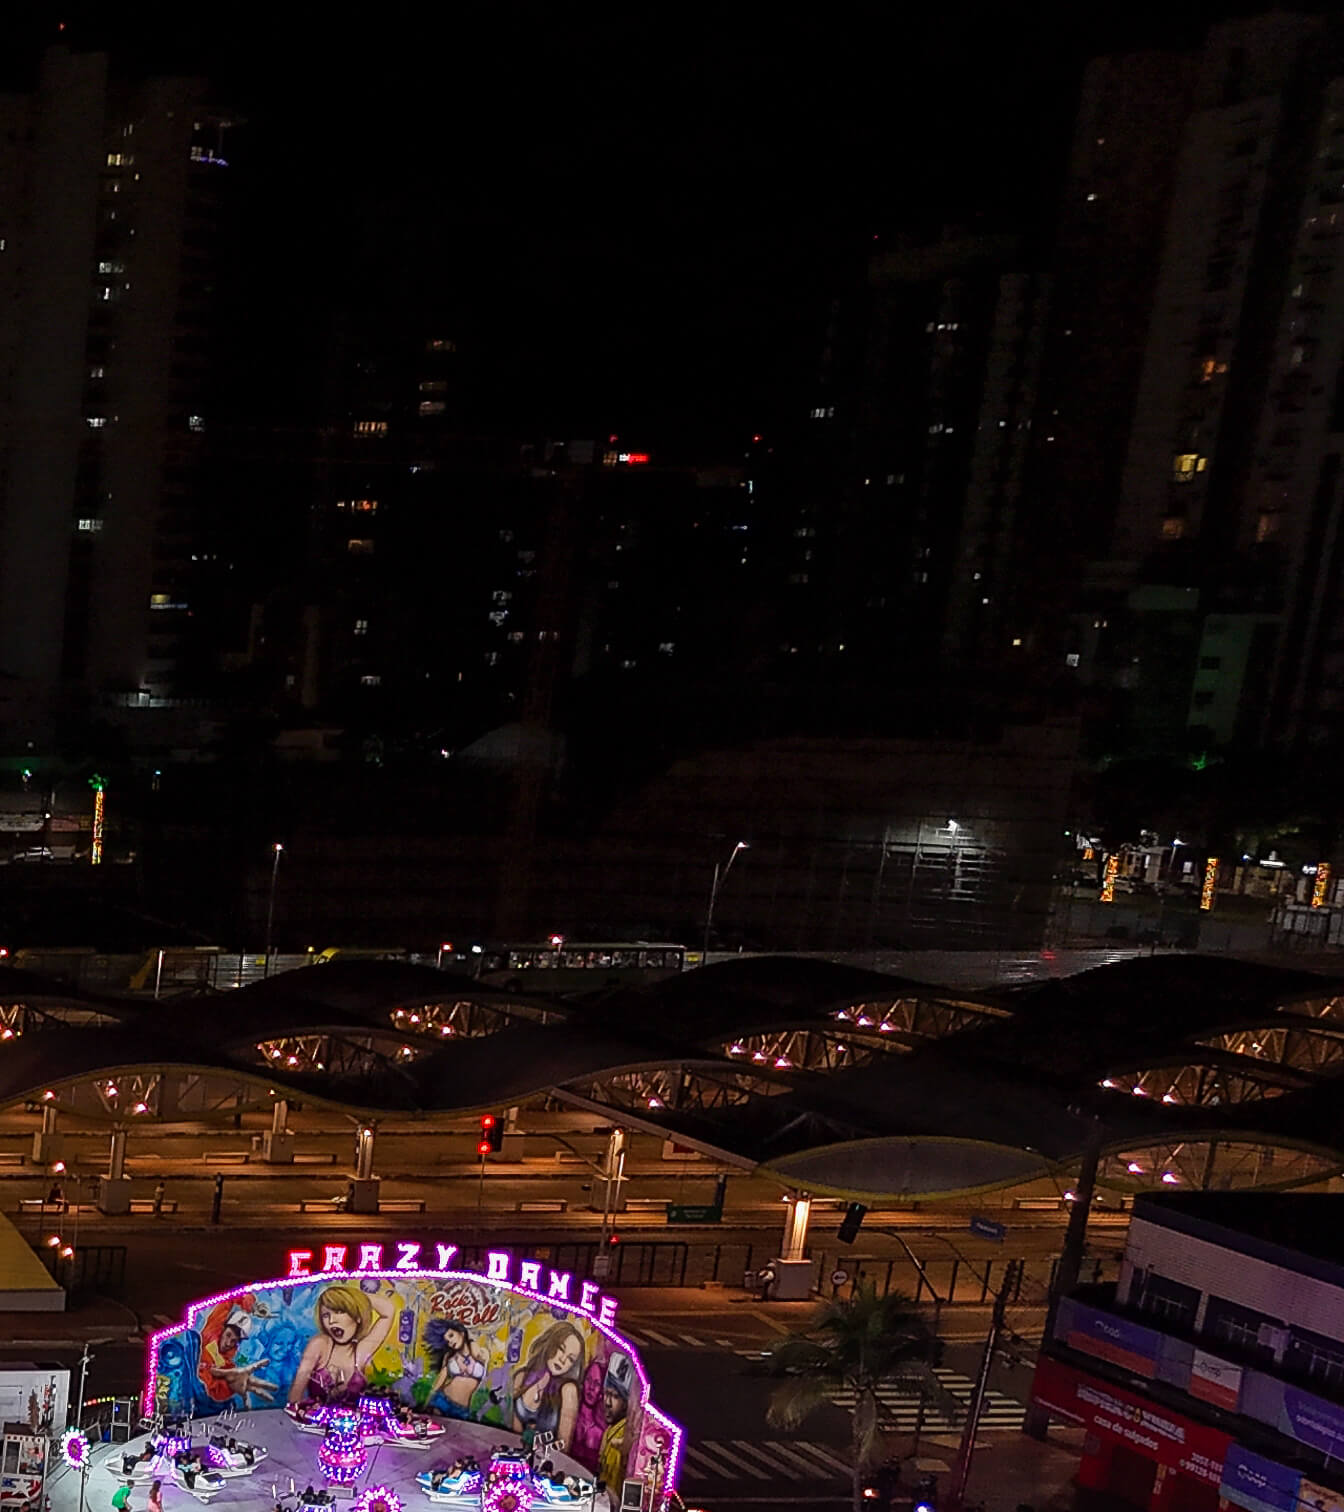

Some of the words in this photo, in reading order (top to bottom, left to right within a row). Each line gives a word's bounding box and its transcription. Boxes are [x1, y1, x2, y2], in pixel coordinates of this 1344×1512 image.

[289, 1243, 457, 1277] CRAZY
[431, 1286, 473, 1315] Rock
[458, 1304, 502, 1328] Roll
